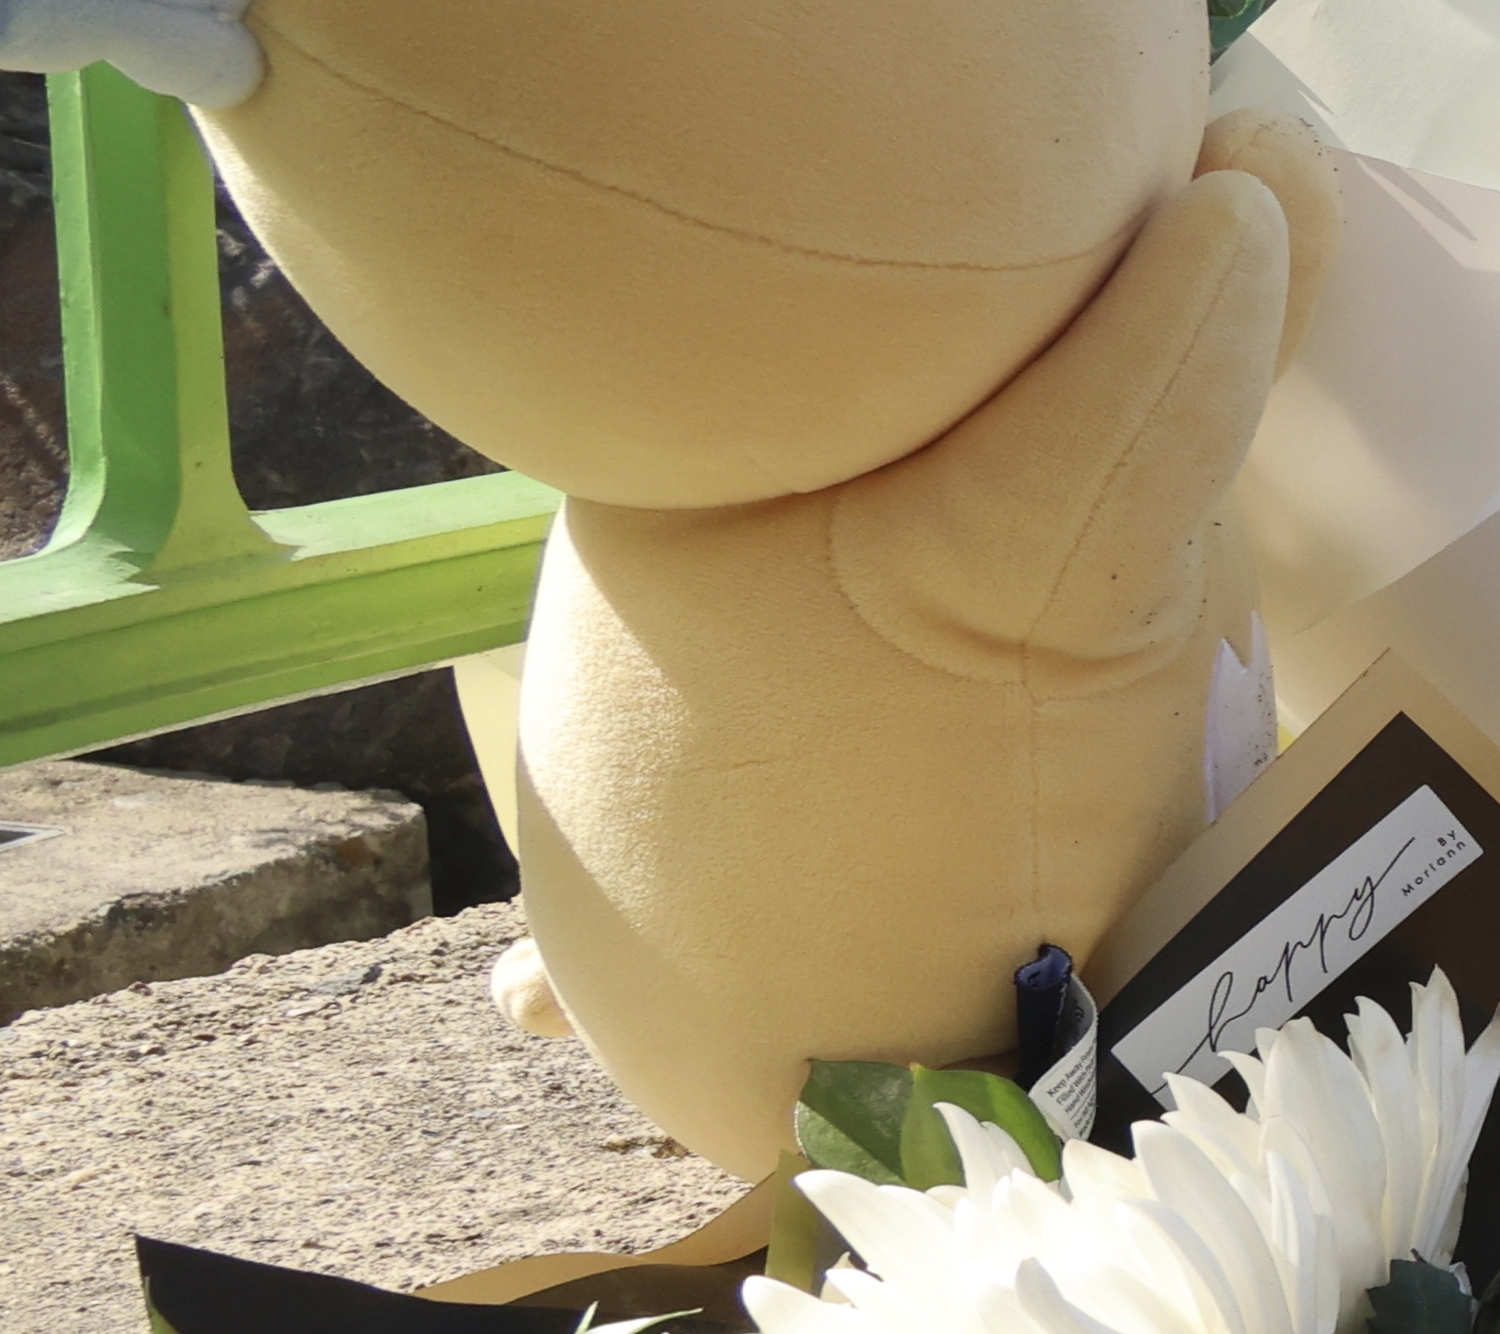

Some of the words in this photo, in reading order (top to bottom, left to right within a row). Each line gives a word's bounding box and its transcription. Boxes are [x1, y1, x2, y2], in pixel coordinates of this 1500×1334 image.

[1437, 828, 1458, 849] By
[1402, 839, 1468, 898] Moriann
[1152, 837, 1416, 1097] happy
[1045, 1078, 1067, 1097] Keep
[1064, 1061, 1083, 1081] Away
[1055, 1083, 1075, 1106] Filled
